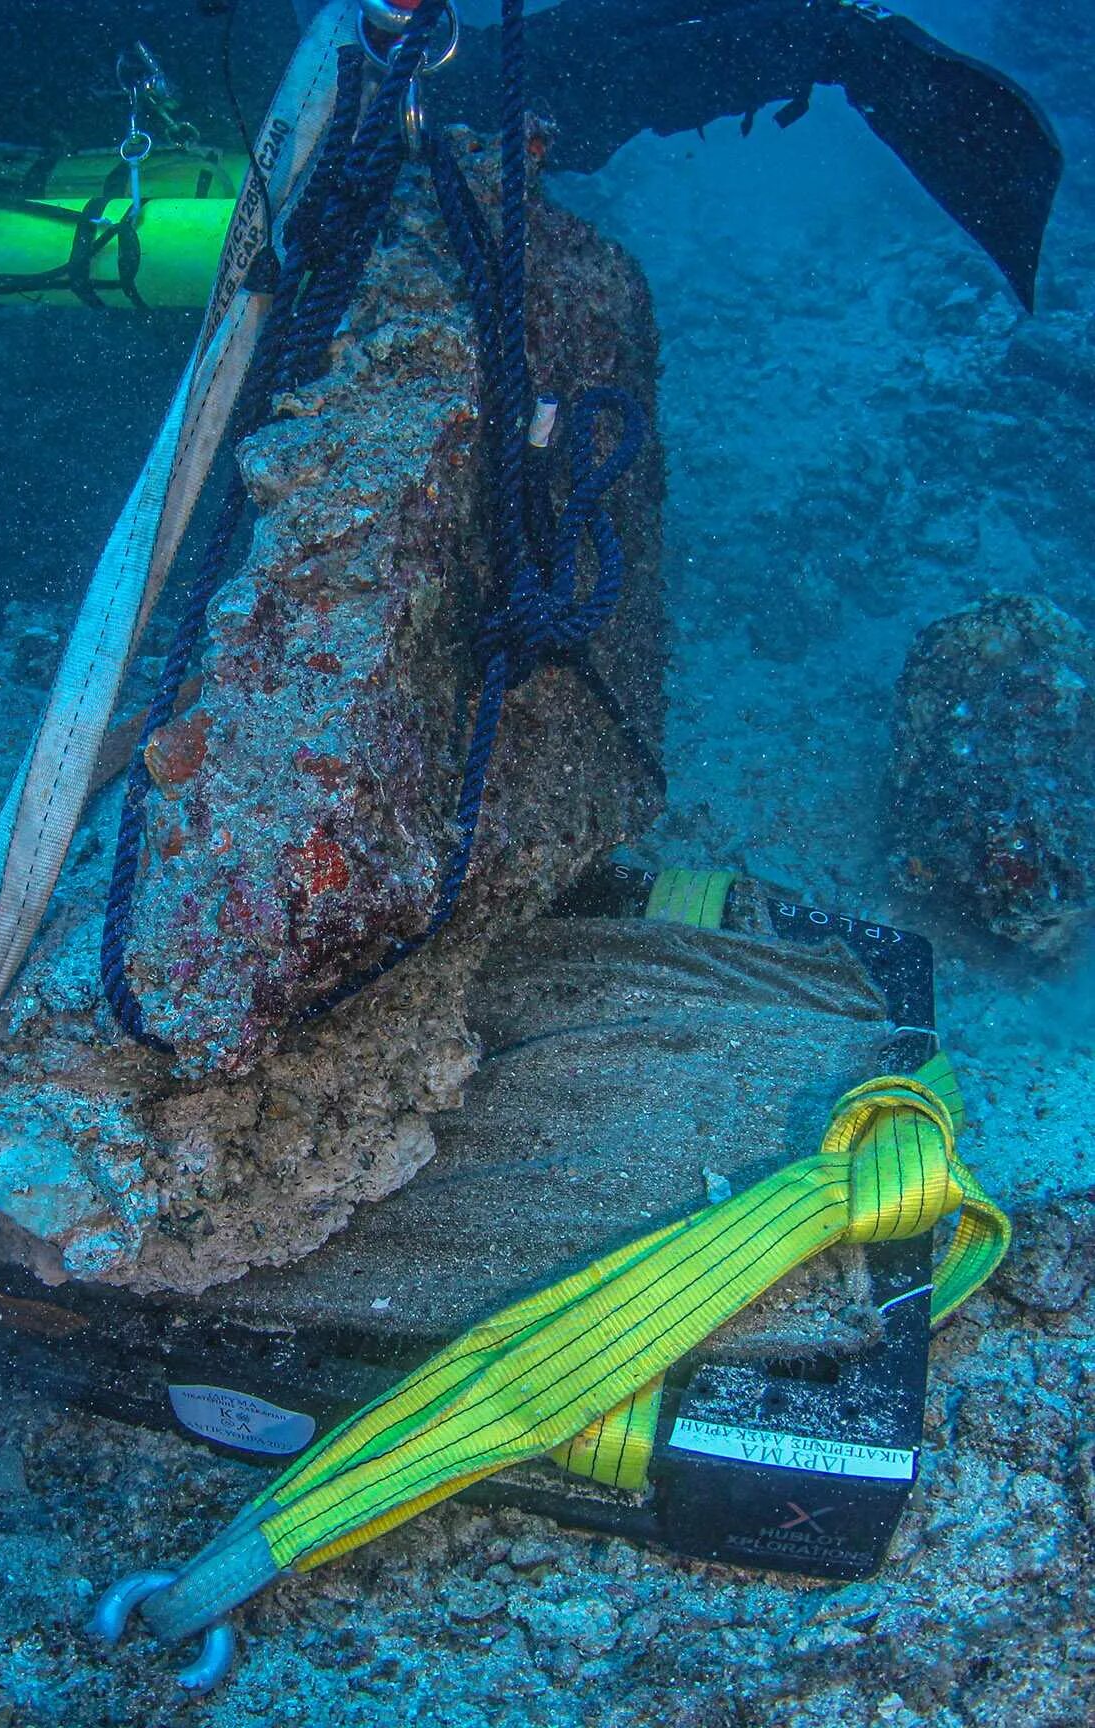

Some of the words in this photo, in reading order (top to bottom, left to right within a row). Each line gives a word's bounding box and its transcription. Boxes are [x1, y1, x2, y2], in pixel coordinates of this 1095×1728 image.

[679, 1420, 785, 1446] ΛΑΣΚΑΡΙΔΗ
[741, 1442, 846, 1474] ΙΔΡΥΜΑ
[790, 1437, 911, 1465] ΑΙΚΑΤΕΡΙΝΗΣ
